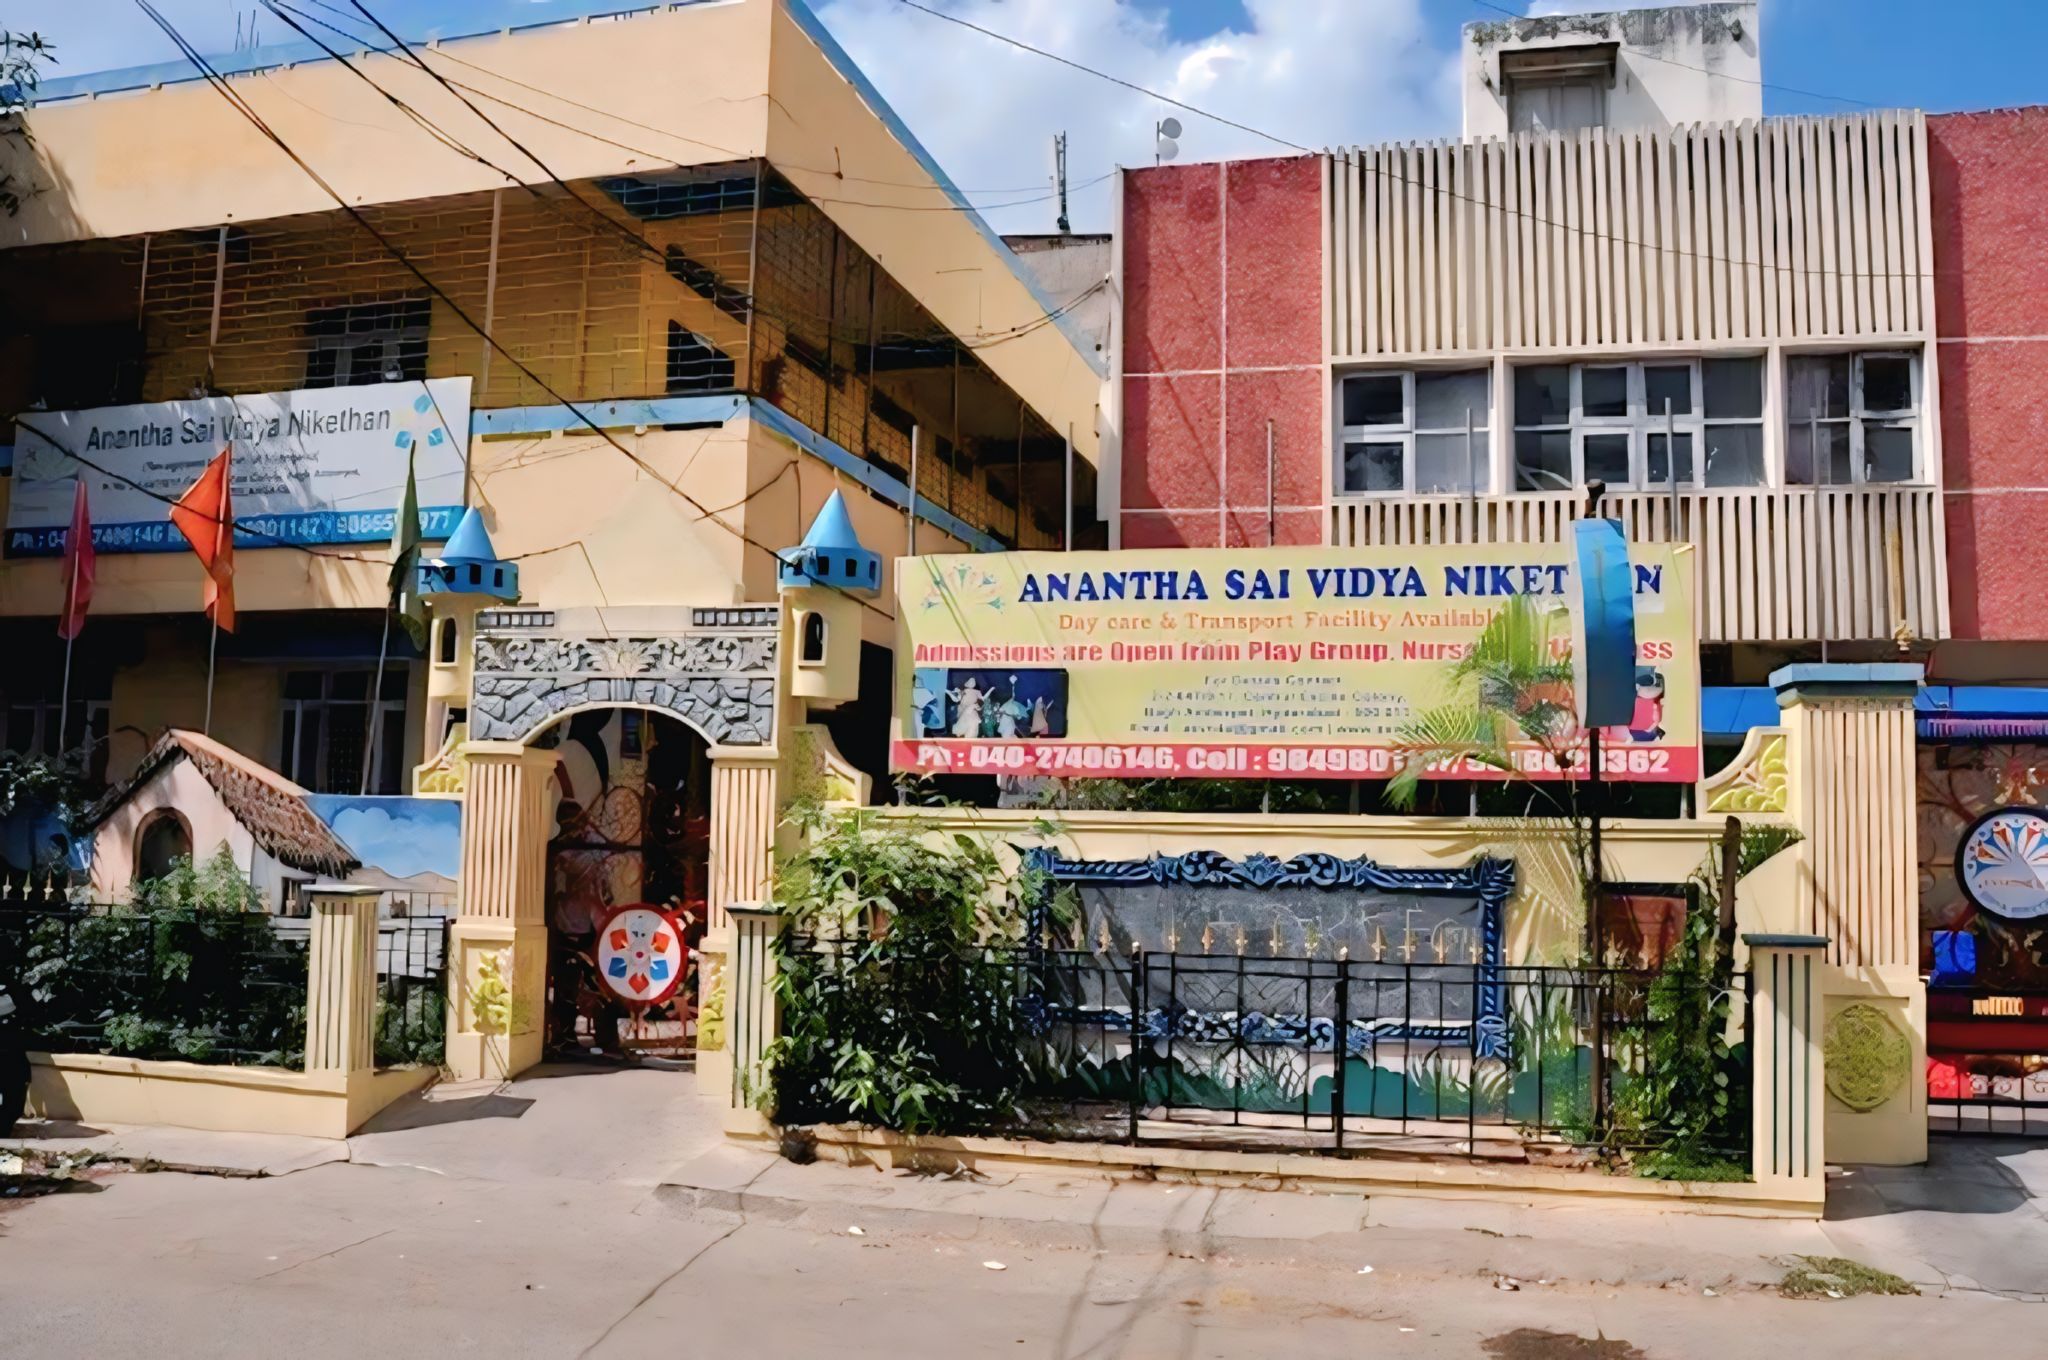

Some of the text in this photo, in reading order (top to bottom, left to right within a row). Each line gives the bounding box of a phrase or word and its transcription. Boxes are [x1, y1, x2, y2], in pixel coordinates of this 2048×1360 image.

[86, 423, 172, 451] Anantha
[180, 416, 214, 445] Sai
[288, 407, 390, 436] Nikethan
[1018, 564, 1663, 602] ANANTHA SAI VIDYA NIKETN
[1059, 608, 1493, 634] Day care & Transport Facility Availabl
[915, 643, 1053, 662] Admissions
[1063, 644, 1102, 661] are
[1111, 642, 1172, 662] Open
[1181, 642, 1240, 661] from
[1249, 641, 1301, 662] Play
[1402, 640, 1474, 660] Nurs
[916, 745, 952, 766] Ph
